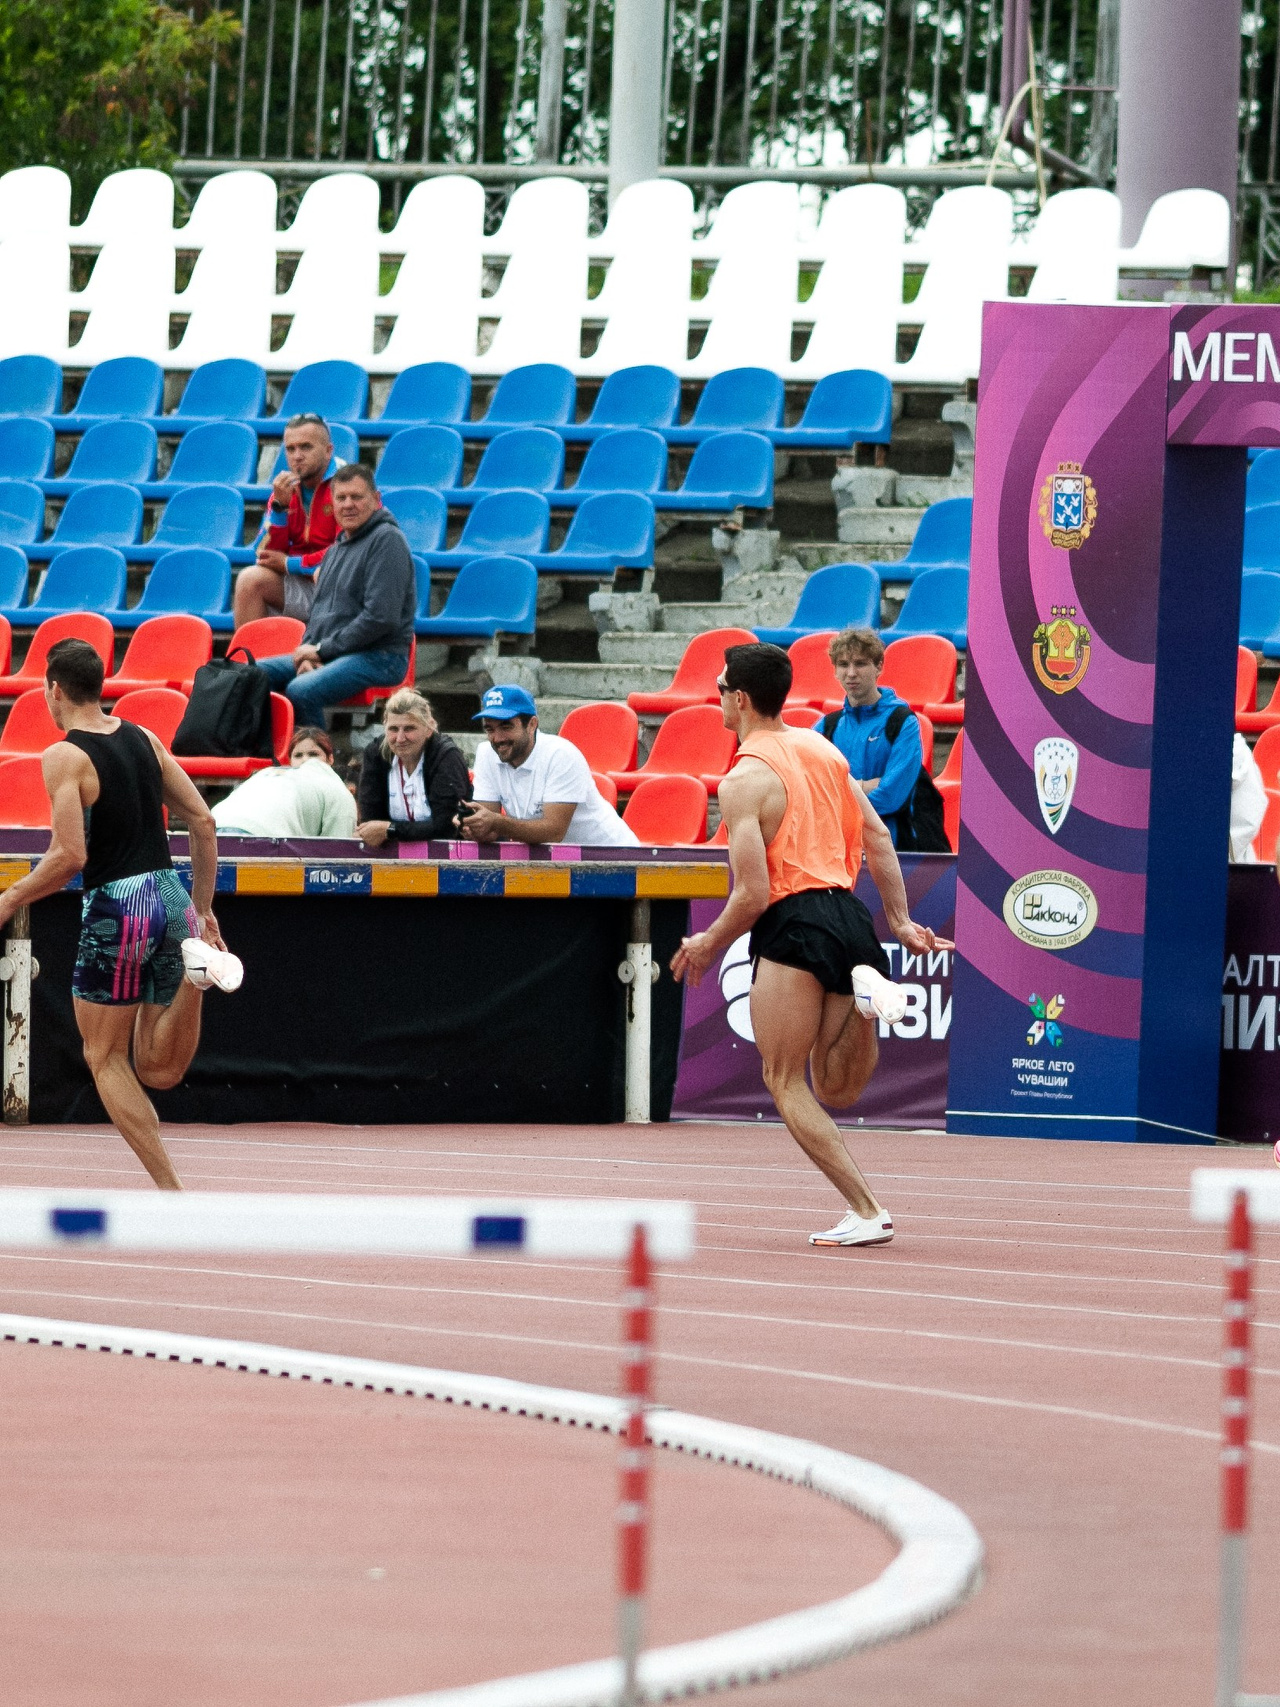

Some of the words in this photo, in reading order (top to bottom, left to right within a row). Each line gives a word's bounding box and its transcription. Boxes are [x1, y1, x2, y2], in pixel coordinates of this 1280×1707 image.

[1012, 1058, 1044, 1070] ЯРКОЕ
[1048, 1061, 1075, 1073] ЛЕТО
[1017, 1074, 1068, 1087] ЧУВАШИИ
